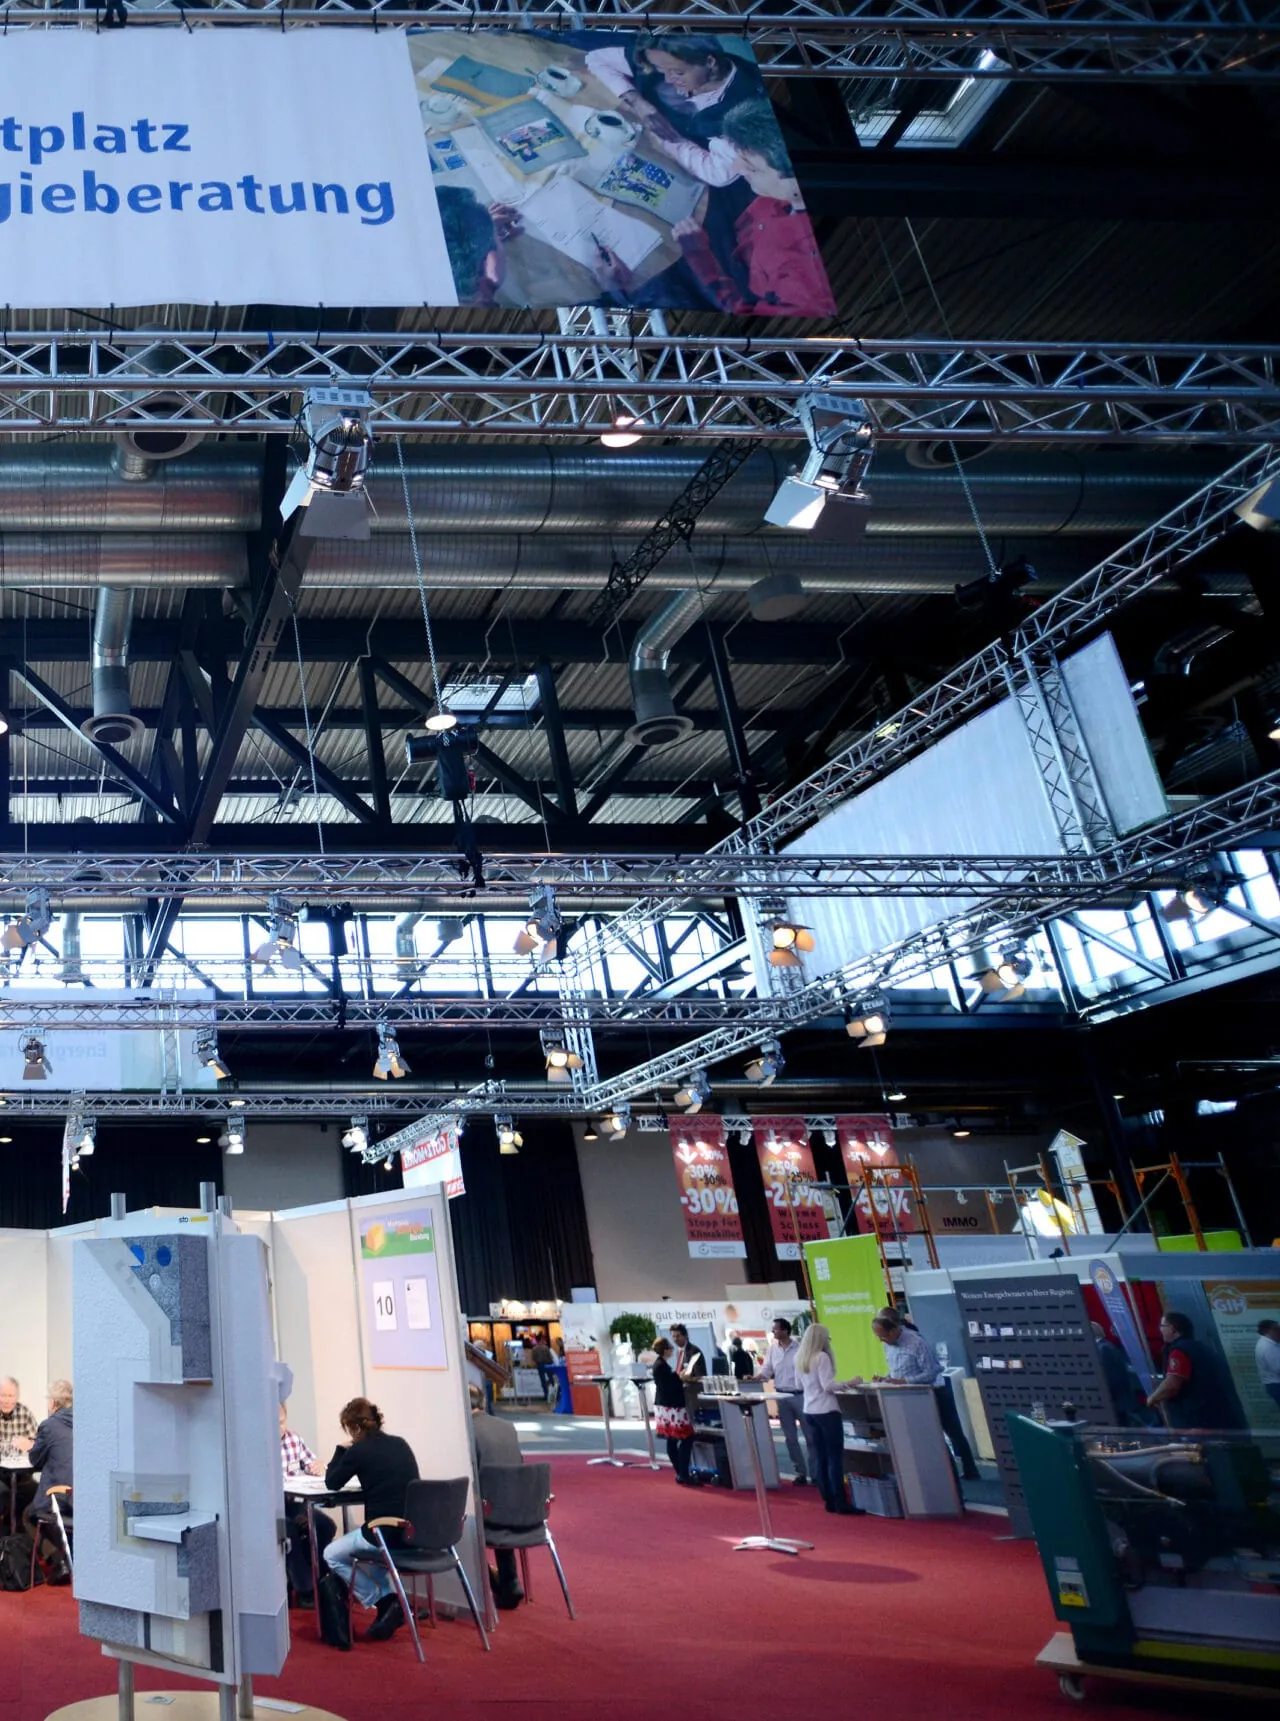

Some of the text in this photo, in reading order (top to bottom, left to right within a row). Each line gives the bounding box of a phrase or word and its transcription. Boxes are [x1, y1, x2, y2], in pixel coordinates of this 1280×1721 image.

[680, 1187, 739, 1214] -30%
[765, 1181, 824, 1208] -25%
[689, 1217, 738, 1229] Stopp für
[780, 1220, 820, 1229] Scluss
[942, 1216, 978, 1228] IMMO
[690, 1229, 740, 1239] Klimakiller
[782, 1232, 821, 1241] Vekauf
[376, 1295, 393, 1316] 10
[656, 1311, 672, 1322] gut
[675, 1309, 718, 1320] beraten!
